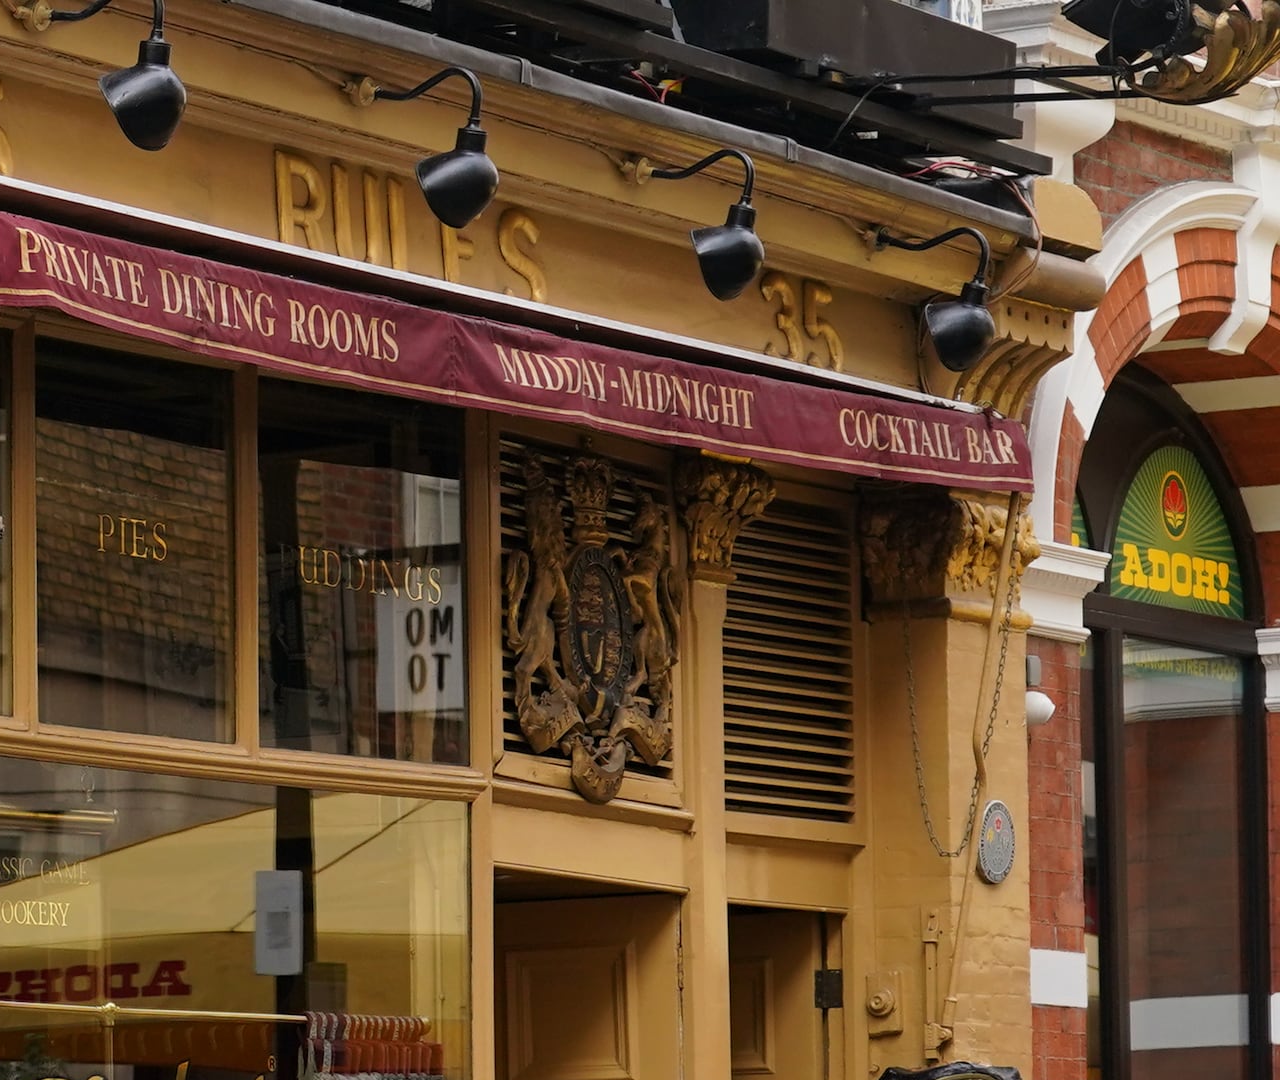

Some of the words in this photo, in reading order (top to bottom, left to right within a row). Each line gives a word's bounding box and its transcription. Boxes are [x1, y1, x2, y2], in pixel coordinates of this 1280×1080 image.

[16, 226, 149, 307] PRIVATE
[158, 267, 276, 337] DINING
[287, 297, 400, 364] ROOMS
[494, 342, 754, 431] MIDDAY-MIDNIGHT
[840, 407, 960, 462] COCKTAIL
[966, 425, 1020, 466] BAR
[96, 513, 169, 562] PIES
[1120, 543, 1231, 605] ADOH!
[40, 859, 90, 885] GAME
